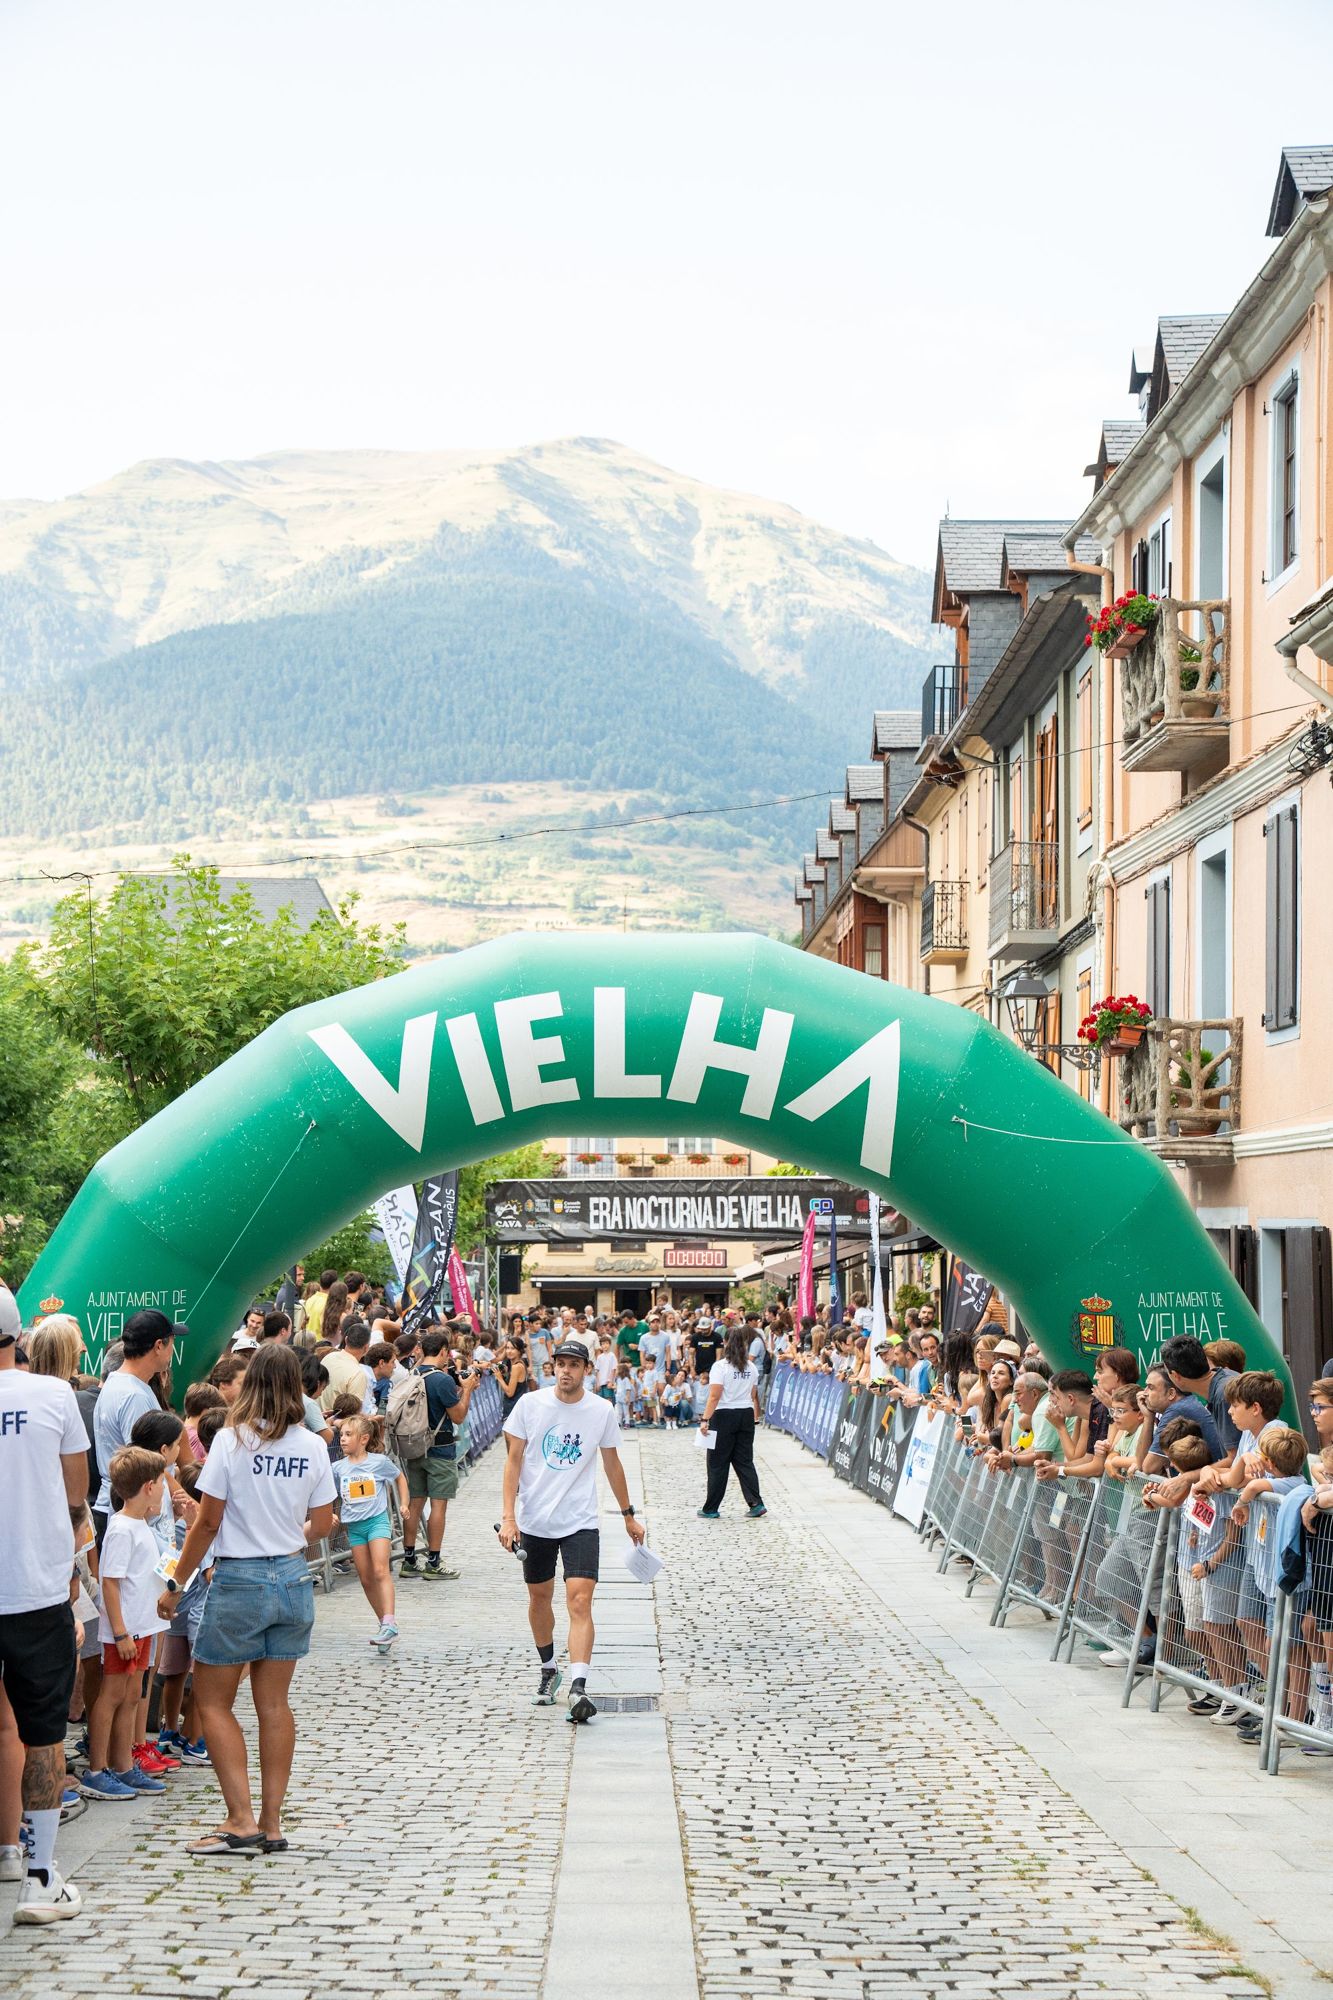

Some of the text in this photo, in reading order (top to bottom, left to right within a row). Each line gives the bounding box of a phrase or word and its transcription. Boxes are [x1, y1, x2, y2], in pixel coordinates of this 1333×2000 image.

[306, 986, 901, 1178] VIELHA
[589, 1194, 804, 1229] ERA NOCTURNA DE VIELHA
[495, 1220, 522, 1228] CAVA
[667, 1251, 723, 1266] 00:00:00
[87, 1290, 187, 1308] AJUNTAMENT DE
[1138, 1292, 1224, 1308] AJUNTAMENT DE
[1216, 1313, 1230, 1341] E
[253, 1455, 309, 1478] STAFF
[359, 1484, 365, 1495] 1
[1194, 1502, 1214, 1525] 1249
